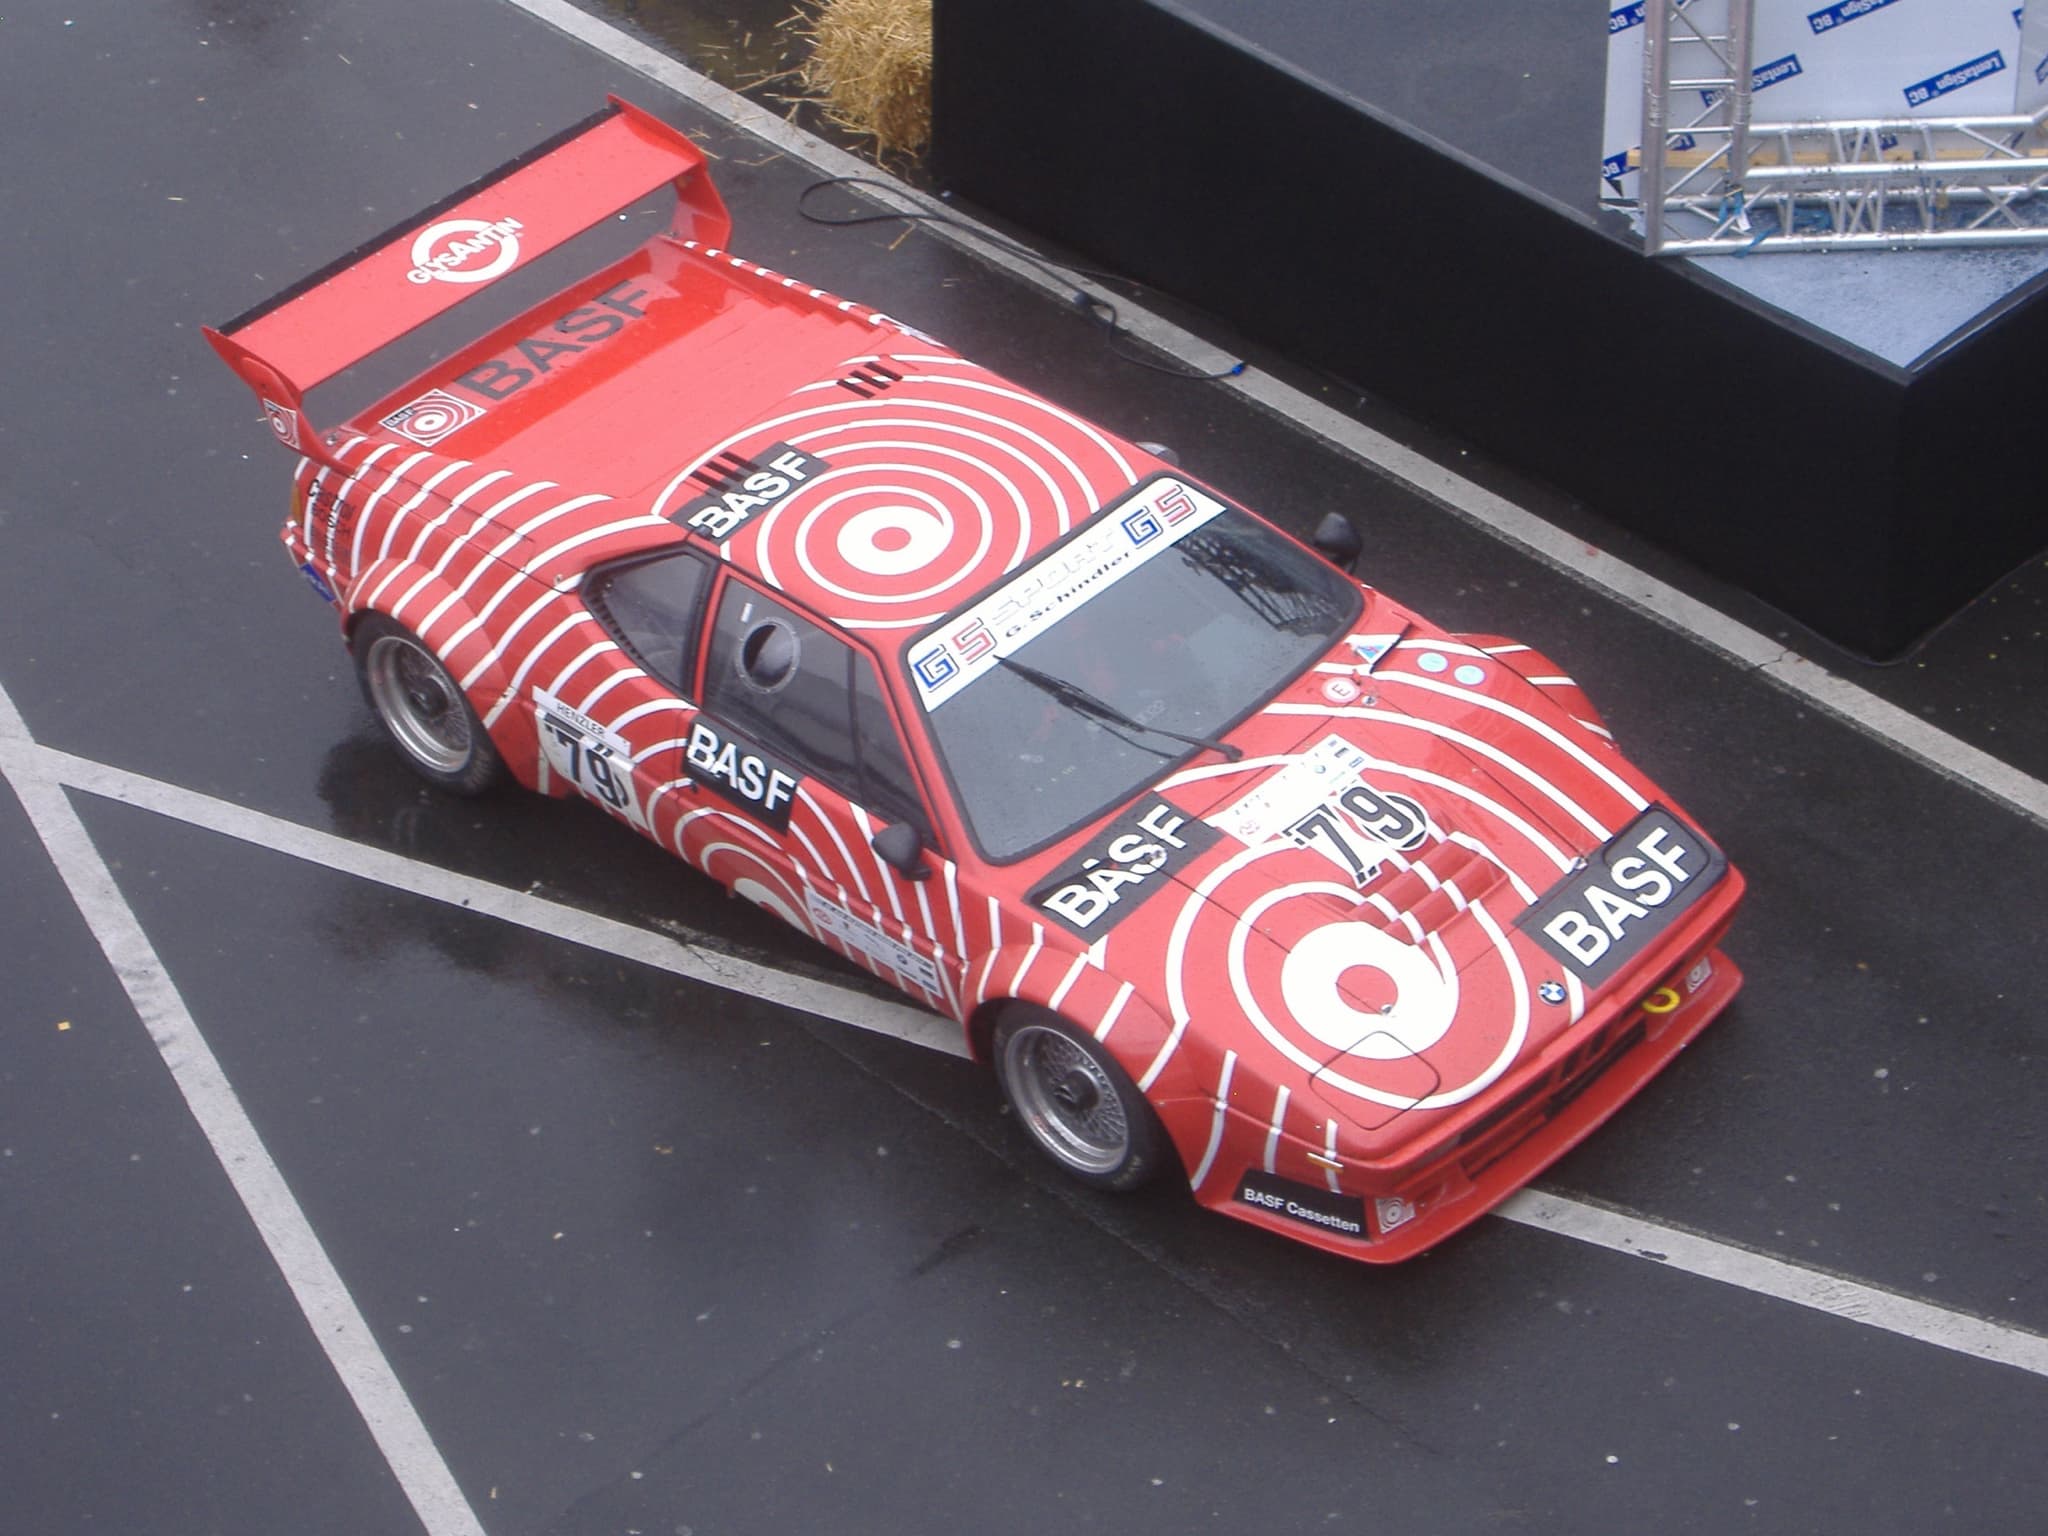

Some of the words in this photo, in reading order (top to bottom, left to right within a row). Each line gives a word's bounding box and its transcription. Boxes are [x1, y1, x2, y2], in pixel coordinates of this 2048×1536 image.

[1813, 14, 1833, 30] BC
[1908, 87, 1929, 103] BC
[407, 216, 524, 285] GLYSANTIN
[457, 280, 653, 401] BASF
[689, 451, 811, 537] BASF
[557, 703, 606, 737] HENZLER
[550, 720, 627, 808] 79
[687, 723, 795, 811] BASF
[1044, 804, 1188, 929] BASF
[1296, 786, 1415, 874] 79
[1544, 828, 1690, 967] BASF
[1243, 1188, 1285, 1210] BASF
[1286, 1201, 1361, 1233] Cassetten
